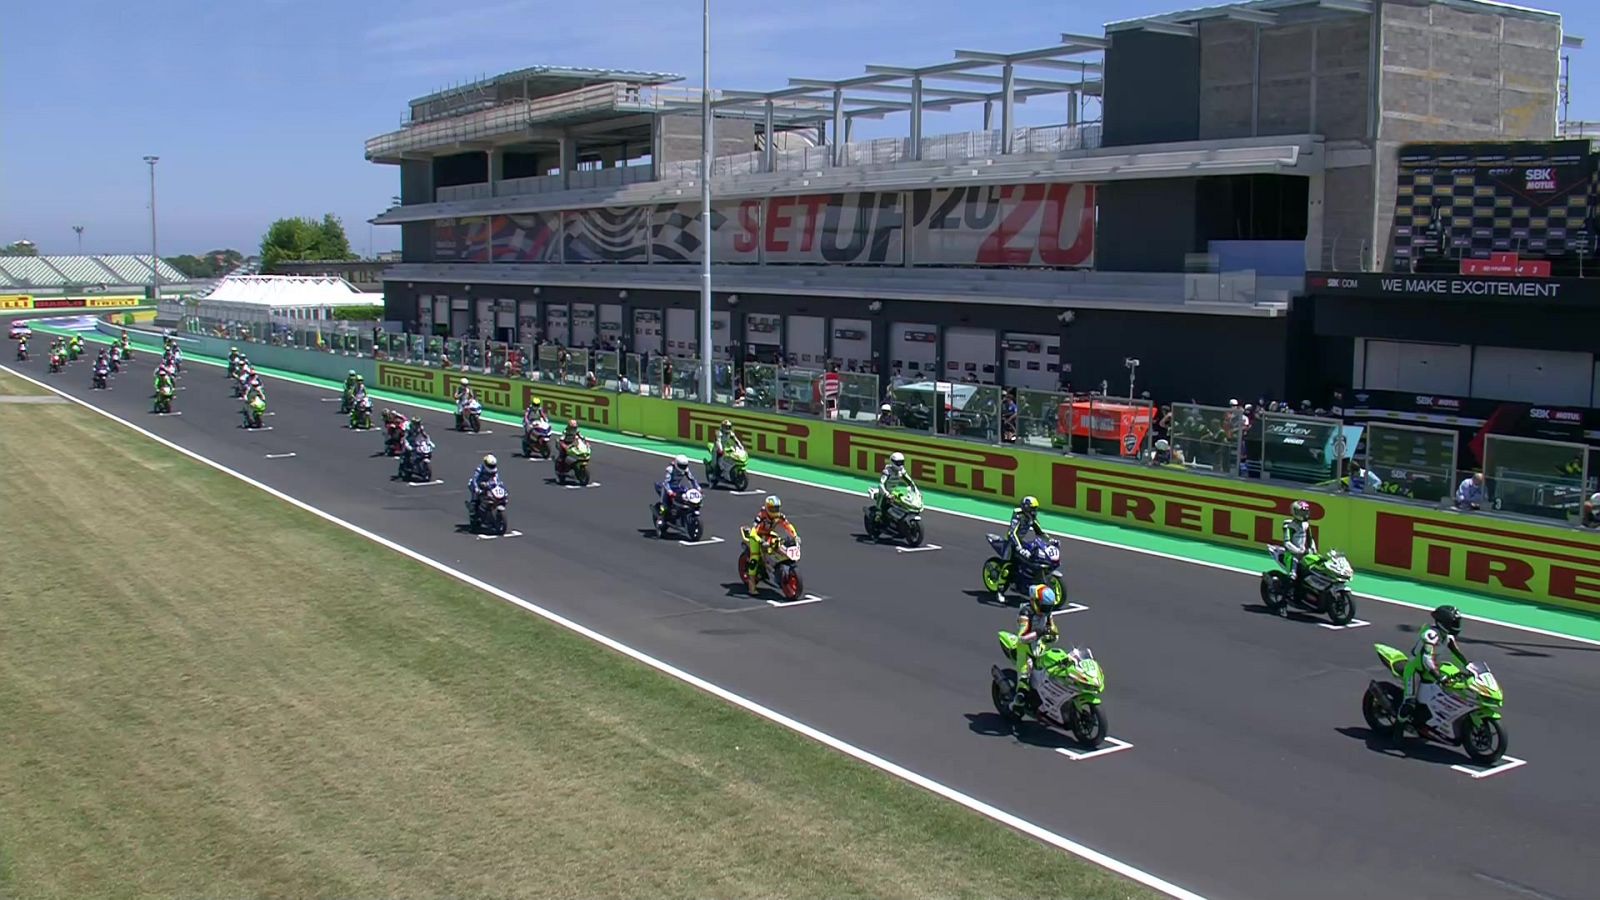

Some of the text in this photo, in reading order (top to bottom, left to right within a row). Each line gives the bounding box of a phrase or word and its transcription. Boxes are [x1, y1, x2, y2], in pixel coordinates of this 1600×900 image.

[1525, 169, 1551, 181] SBK
[1526, 181, 1555, 190] MOTUL
[1381, 279, 1560, 297] WE MAKE EXCITEMENT
[380, 364, 434, 394] PIRELLI
[522, 385, 610, 425] PRELLI
[1530, 408, 1549, 418] SBK
